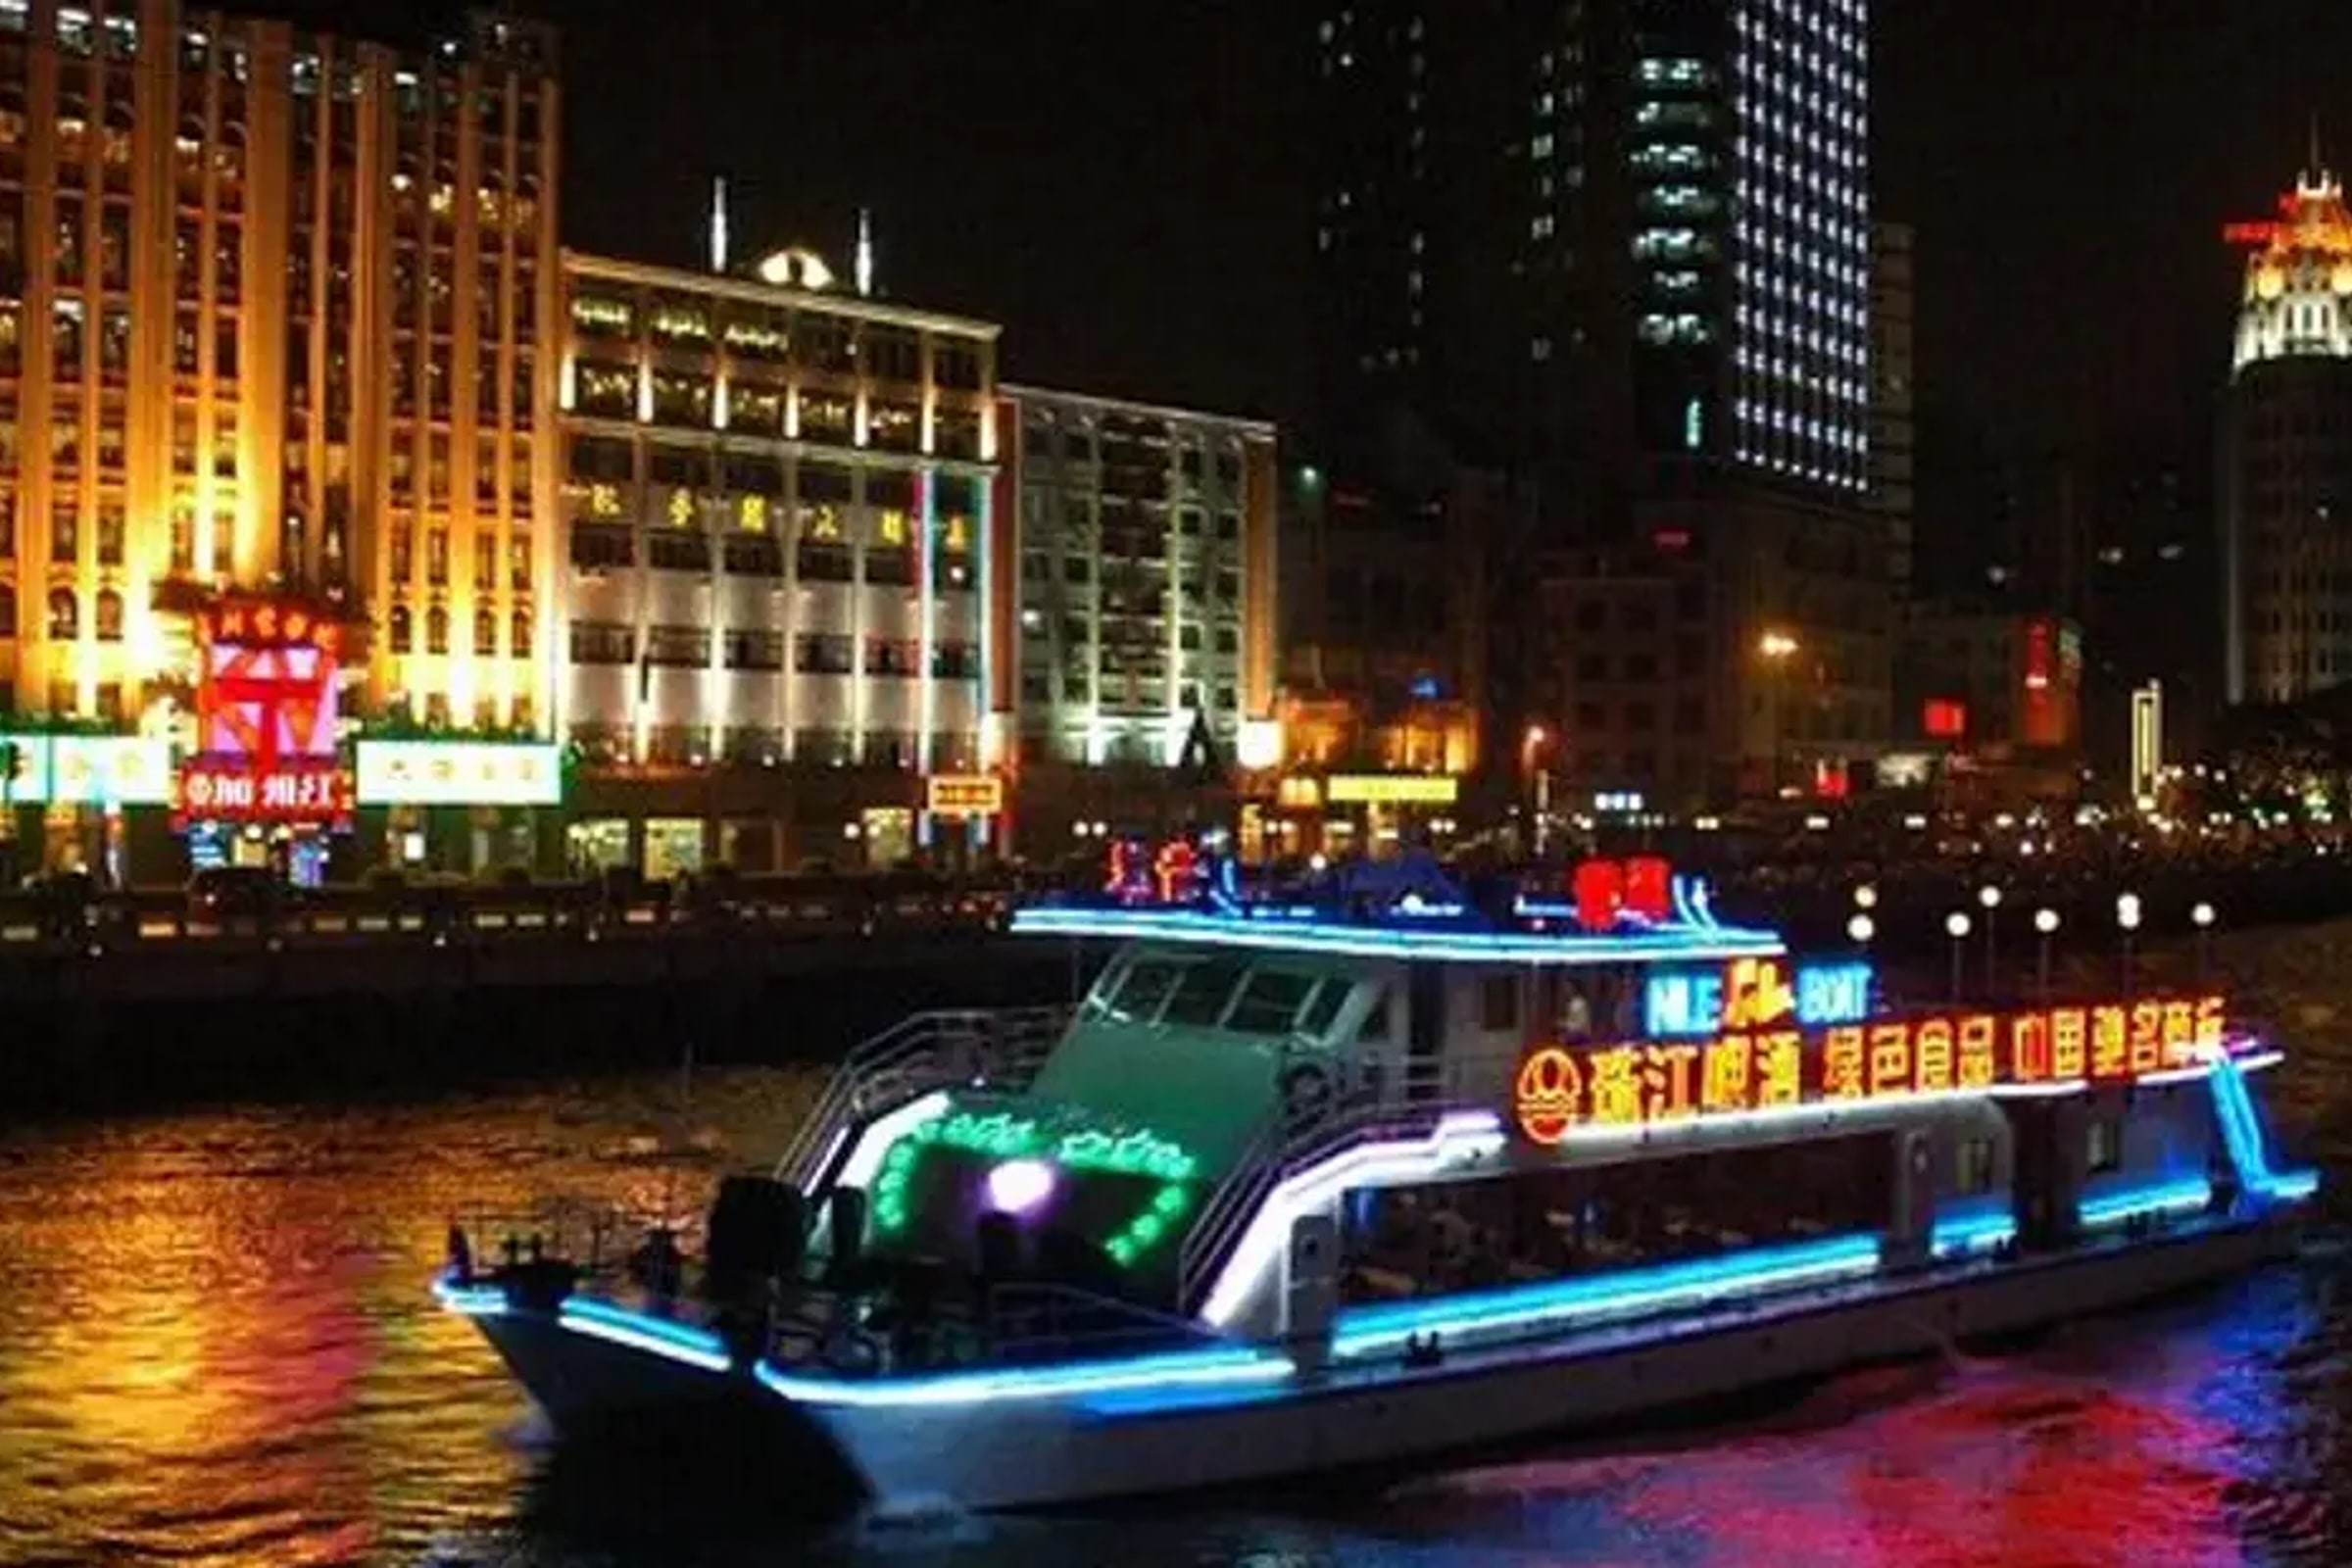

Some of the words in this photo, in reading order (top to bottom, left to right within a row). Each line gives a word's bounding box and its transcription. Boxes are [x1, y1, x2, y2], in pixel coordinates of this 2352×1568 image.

[1589, 1032, 1801, 1123] 珠江啤酒
[1824, 1015, 1994, 1100] 绿色食品
